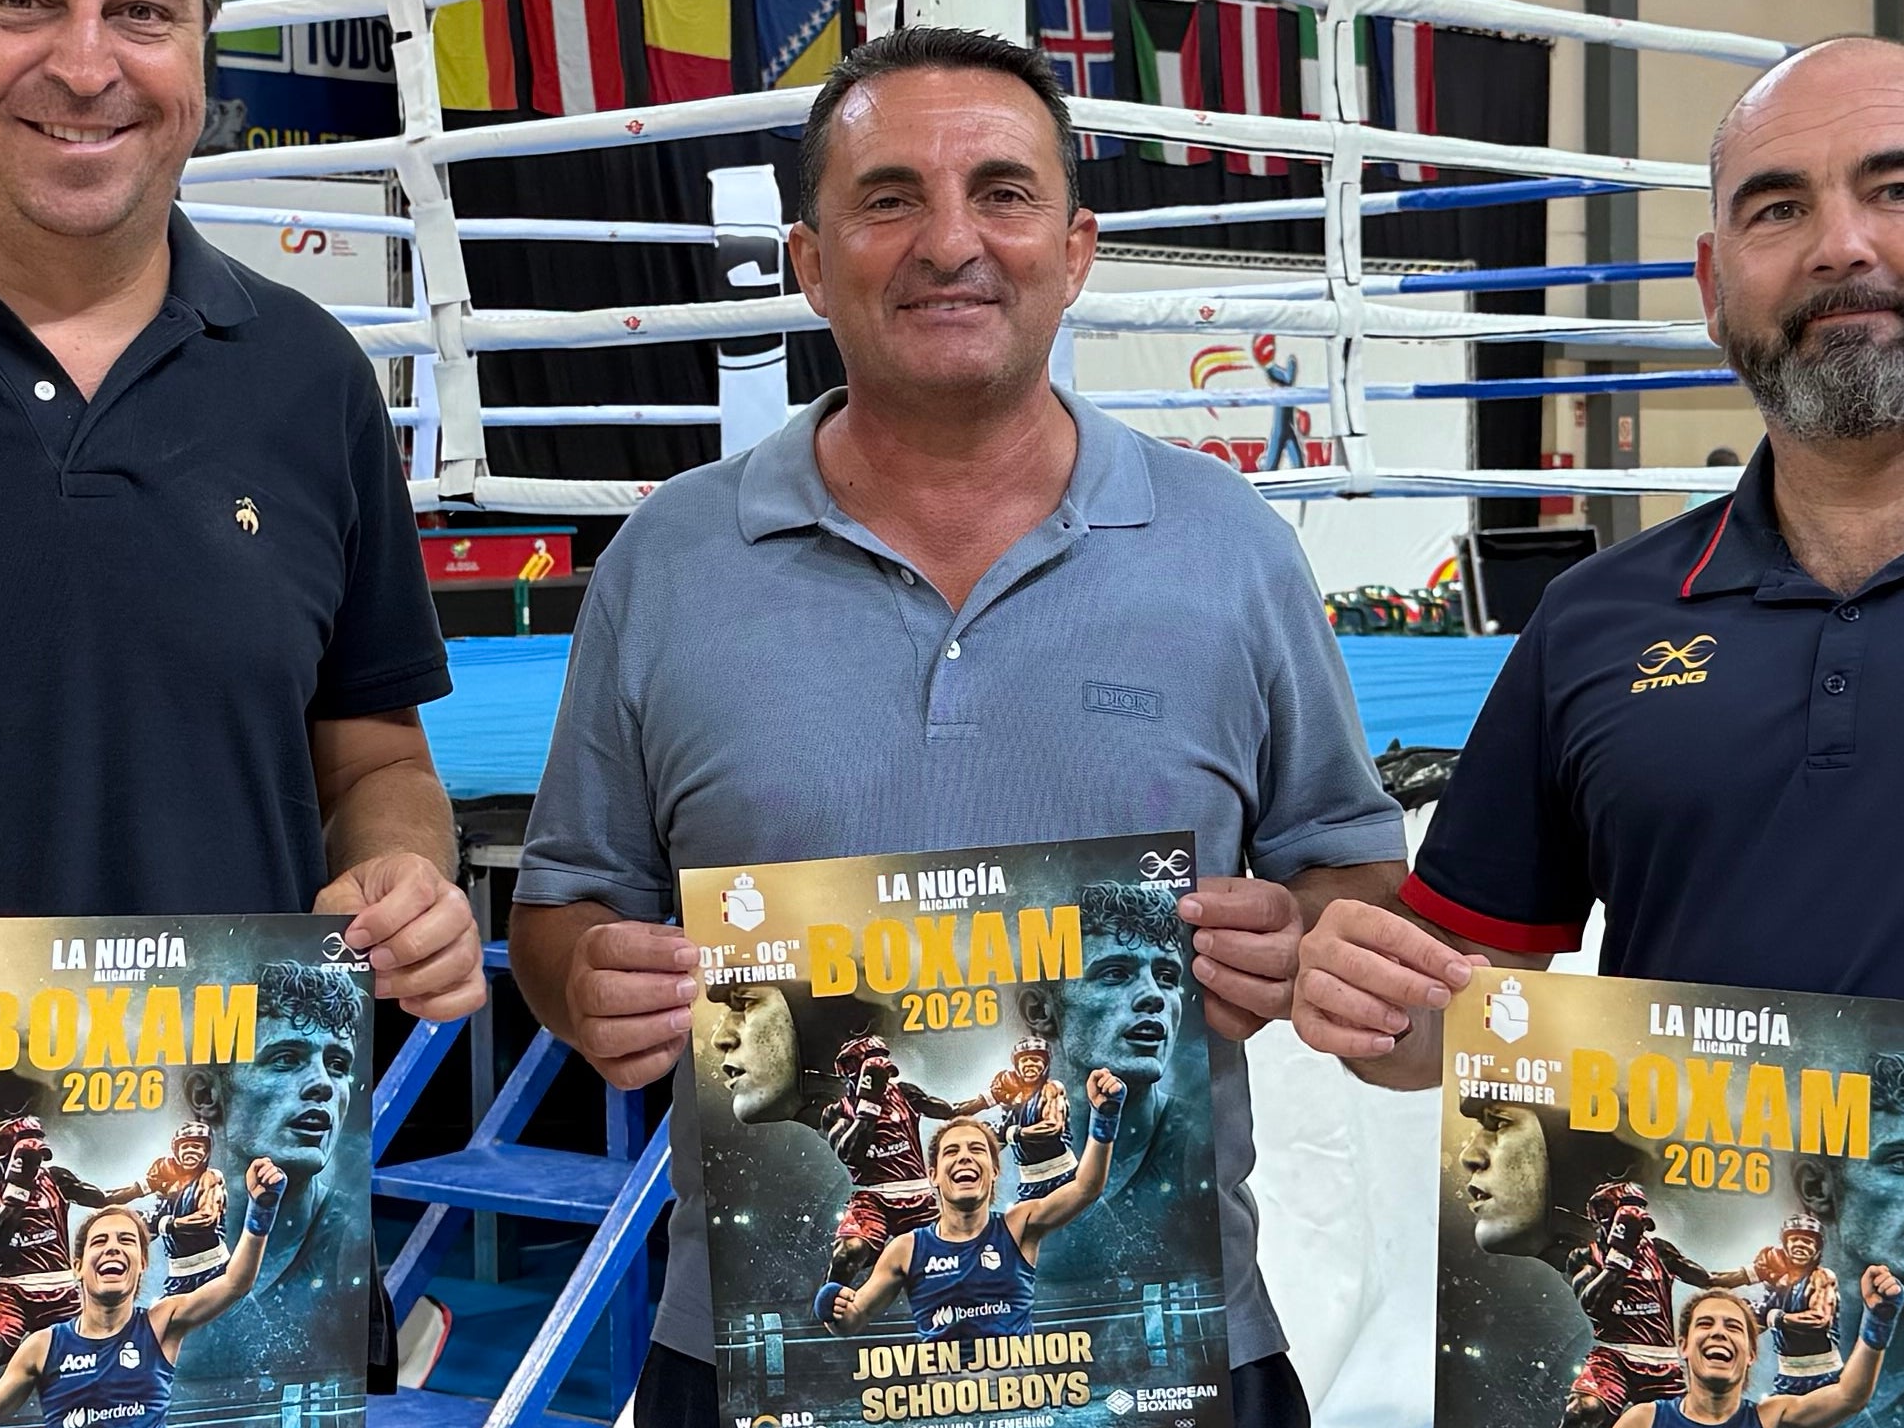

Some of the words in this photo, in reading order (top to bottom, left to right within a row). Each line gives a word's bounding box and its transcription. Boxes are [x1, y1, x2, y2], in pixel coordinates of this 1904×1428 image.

[1630, 671, 1708, 694] STING
[1097, 688, 1151, 714] DIOR
[877, 873, 911, 903] LA
[917, 861, 1007, 899] NUCÍA
[1140, 876, 1191, 890] STING
[919, 897, 969, 912] ALICANTE
[52, 938, 88, 971] LA
[94, 931, 187, 970] NUCÍA
[807, 905, 1085, 998] BOXAM
[93, 970, 146, 983] ALICANTE
[320, 960, 370, 973] STING
[704, 962, 796, 986] SEPTEMBER
[901, 988, 999, 1032] 2026
[1649, 1003, 1685, 1039] LA
[1693, 1007, 1791, 1047] NUCÍA
[1692, 1039, 1748, 1057] ALICANTE
[61, 1070, 165, 1113] 2026
[1459, 1078, 1556, 1106] SEPTEMBER
[1569, 1048, 1872, 1160] BOXAM
[1664, 1143, 1772, 1195] 2026
[955, 1300, 1012, 1322] Iberdrola
[853, 1340, 962, 1380] JOVEN
[968, 1331, 1094, 1372] JUNIOR
[861, 1371, 1091, 1422] SCHOOLBOYS
[1136, 1384, 1218, 1401] EUROPEAN
[1137, 1398, 1193, 1413] BOXING
[87, 1401, 145, 1425] Iberdrola
